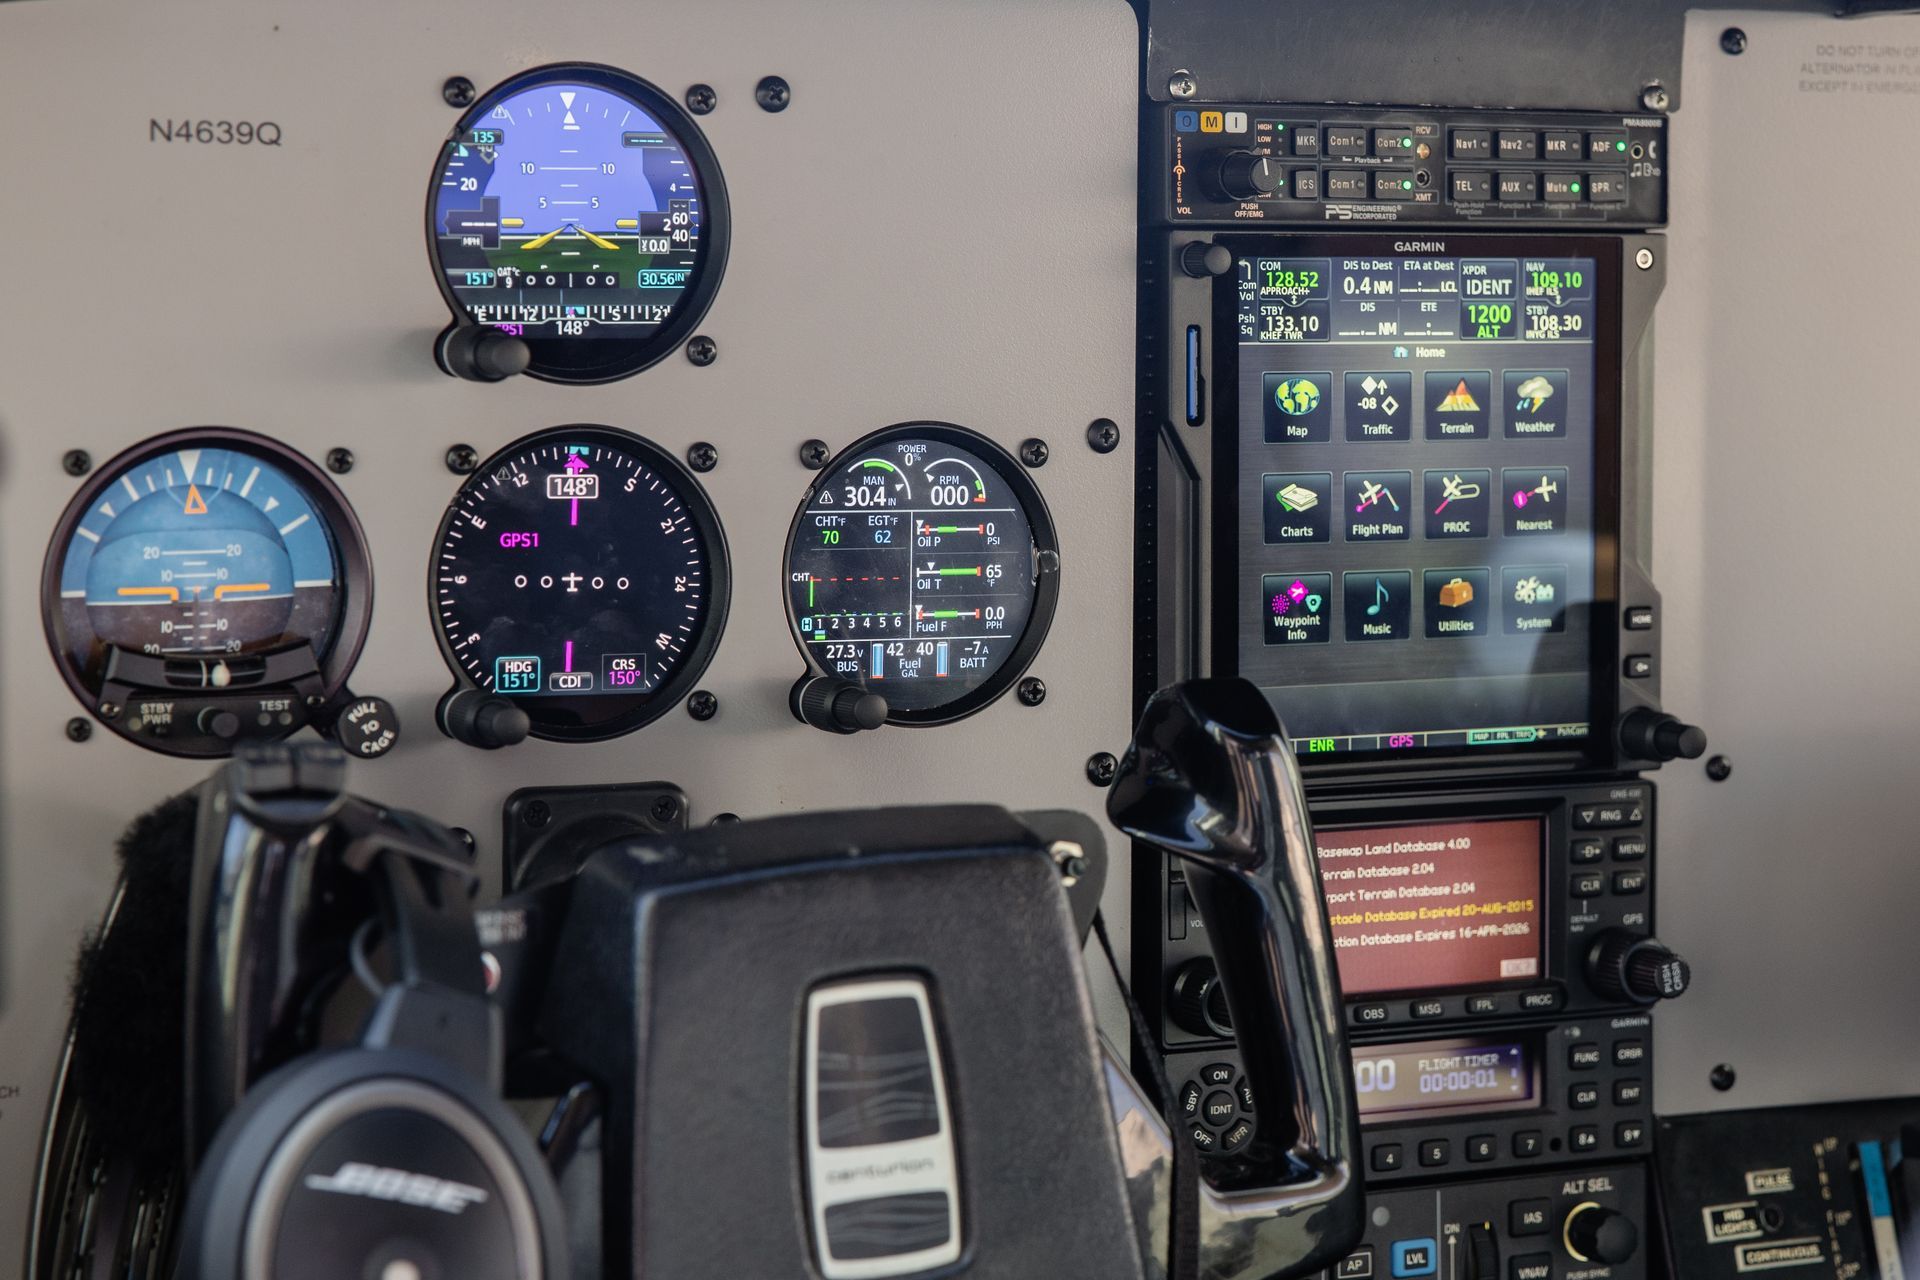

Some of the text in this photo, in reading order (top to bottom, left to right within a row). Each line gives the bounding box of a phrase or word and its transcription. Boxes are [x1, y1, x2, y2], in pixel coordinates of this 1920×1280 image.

[148, 118, 282, 147] N4639Q
[1257, 123, 1273, 131] HIGH
[1415, 126, 1432, 135] RCV
[473, 131, 495, 143] 135
[1257, 135, 1272, 143] LOW
[1296, 135, 1316, 146] MKR
[1330, 136, 1402, 148] Com1 Com2
[1456, 139, 1611, 152] Nav1 Nav2 MKR ADF
[521, 163, 615, 175] 10 10
[460, 178, 478, 191] 20
[1298, 179, 1314, 190] ICS
[1330, 179, 1402, 190] Com1 Com2
[1456, 181, 1610, 193] TEL AUX Mute SPR
[1415, 193, 1432, 202] XMT
[1177, 207, 1192, 215] VOL
[1353, 212, 1397, 220] INCORPORATED
[1394, 241, 1446, 253] GARMIN
[1260, 261, 1282, 271] COM
[1343, 260, 1393, 270] DIS to Dest
[1404, 261, 1454, 271] ETA at Dest
[1462, 265, 1487, 276] XPDR
[1526, 262, 1545, 272] NAV
[1266, 271, 1319, 288] 128.52
[1343, 276, 1393, 295] 0.4 NM
[1531, 272, 1582, 288] 109.10
[1466, 279, 1512, 296] IDENT
[1240, 291, 1255, 301] Vol
[1260, 306, 1284, 316] STBY
[1360, 302, 1376, 312] DIS
[1420, 302, 1437, 312] ETE
[1526, 306, 1549, 316] STBY
[1468, 305, 1512, 324] 1200
[1266, 316, 1319, 332] 133.10
[1531, 315, 1582, 332] 108.30
[1260, 331, 1303, 340] KHEF TWR
[1477, 325, 1501, 339] ALT
[1415, 347, 1446, 358] Home
[1287, 425, 1308, 438] Map
[1362, 423, 1394, 435] Traffic
[1440, 422, 1475, 434] Terrain
[1515, 421, 1555, 433] Weather
[898, 444, 927, 453] POWER
[512, 473, 529, 488] 12
[863, 476, 884, 485] MAN
[939, 476, 960, 485] RPM
[844, 486, 887, 507] 30.4
[930, 486, 969, 506] 000
[1352, 523, 1404, 538] Flight Plan
[1443, 521, 1470, 533] PROC
[1516, 519, 1553, 531] Nearest
[822, 531, 840, 544] 70
[874, 530, 892, 543] 62
[1281, 526, 1314, 538] Charts
[500, 532, 539, 548] GPS1
[917, 536, 932, 547] Oil
[987, 536, 1000, 545] PSI
[143, 545, 242, 559] 20 20
[792, 573, 810, 582] CHT
[986, 565, 1002, 578] 65
[917, 579, 932, 590] Oil
[985, 607, 1005, 620] 0.0
[916, 621, 938, 632] Fuel
[986, 620, 1003, 629] PPH
[1274, 615, 1321, 629] Waypoint
[1438, 620, 1474, 632] Utilities
[1516, 617, 1552, 630] System
[1287, 628, 1307, 641] Info
[1363, 623, 1392, 635] Music
[826, 645, 855, 659] 27.3
[886, 642, 934, 655] 42 40
[505, 661, 532, 674] HDG
[612, 658, 636, 671] CRS
[837, 661, 859, 672] BUS
[899, 658, 921, 669] Fuel
[959, 657, 987, 668] BATT
[901, 669, 919, 678] GAL
[558, 676, 581, 688] CDI
[140, 703, 174, 715] STBY
[260, 700, 291, 711] TEST
[347, 701, 378, 724] PULL
[142, 713, 172, 725] PWR
[360, 719, 380, 735] TO
[360, 729, 395, 754] CAGE
[1309, 738, 1335, 752] ENR
[1388, 735, 1414, 748] GPS
[1600, 811, 1621, 821] RNG
[1317, 839, 1445, 858] Basemap Land Database
[1619, 844, 1646, 854] MENU
[1321, 865, 1410, 880] errain Database
[1581, 880, 1600, 891] CLR
[1622, 878, 1642, 888] ENT
[1358, 885, 1451, 901] Terrain Database
[1365, 910, 1417, 923] Database
[1419, 905, 1461, 921] Expired
[1622, 913, 1643, 925] GPS
[1361, 929, 1456, 946] Database Expires
[1476, 999, 1494, 1010] FPL
[1526, 994, 1553, 1007] PROC
[1363, 1008, 1385, 1020] OBS
[1419, 1003, 1441, 1015] MSG
[1418, 1053, 1500, 1072] FLIGHT TIMER
[1574, 1051, 1599, 1063] FUNC
[1213, 1071, 1228, 1080] ON
[1419, 1068, 1499, 1093] 00:00:01
[1577, 1090, 1596, 1103] CLR
[1621, 1087, 1640, 1099] ENT
[1186, 1090, 1198, 1112] SBY
[1210, 1104, 1232, 1115] IDNT
[1194, 1130, 1212, 1146] OFF
[1230, 1126, 1248, 1144] VFR
[825, 1156, 934, 1185] centurion
[305, 1160, 488, 1215] BOSE
[1562, 1178, 1613, 1195] ALT SEL
[1523, 1212, 1543, 1225] IAS
[1405, 1252, 1427, 1265] LVL
[1346, 1259, 1364, 1272] AP
